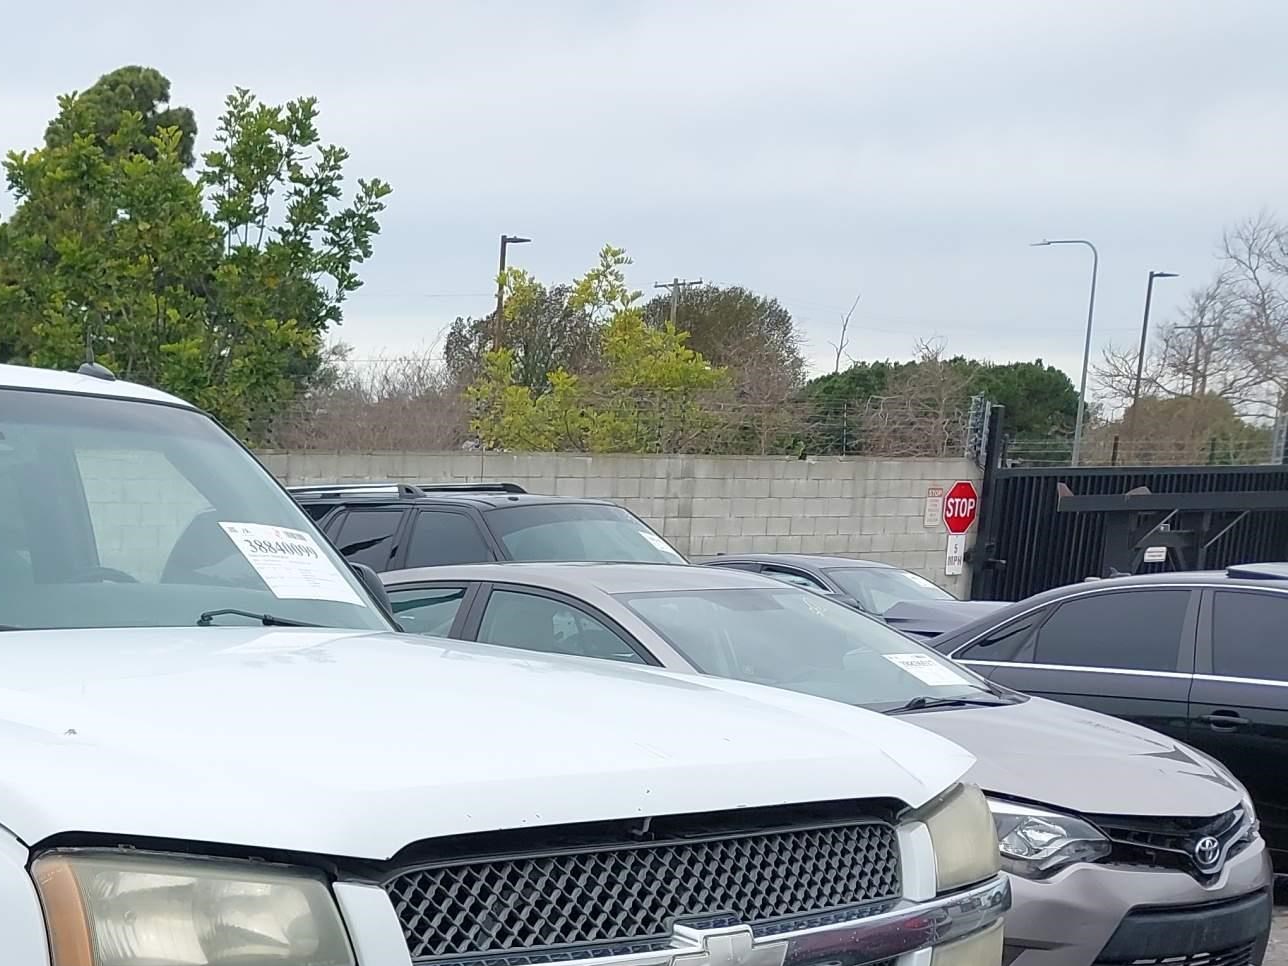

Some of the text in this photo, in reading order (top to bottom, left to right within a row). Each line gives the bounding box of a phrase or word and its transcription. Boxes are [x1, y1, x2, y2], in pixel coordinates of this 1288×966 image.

[946, 498, 975, 518] STOP
[244, 539, 319, 559] 38840099
[954, 544, 959, 554] 5
[947, 555, 962, 566] MPH
